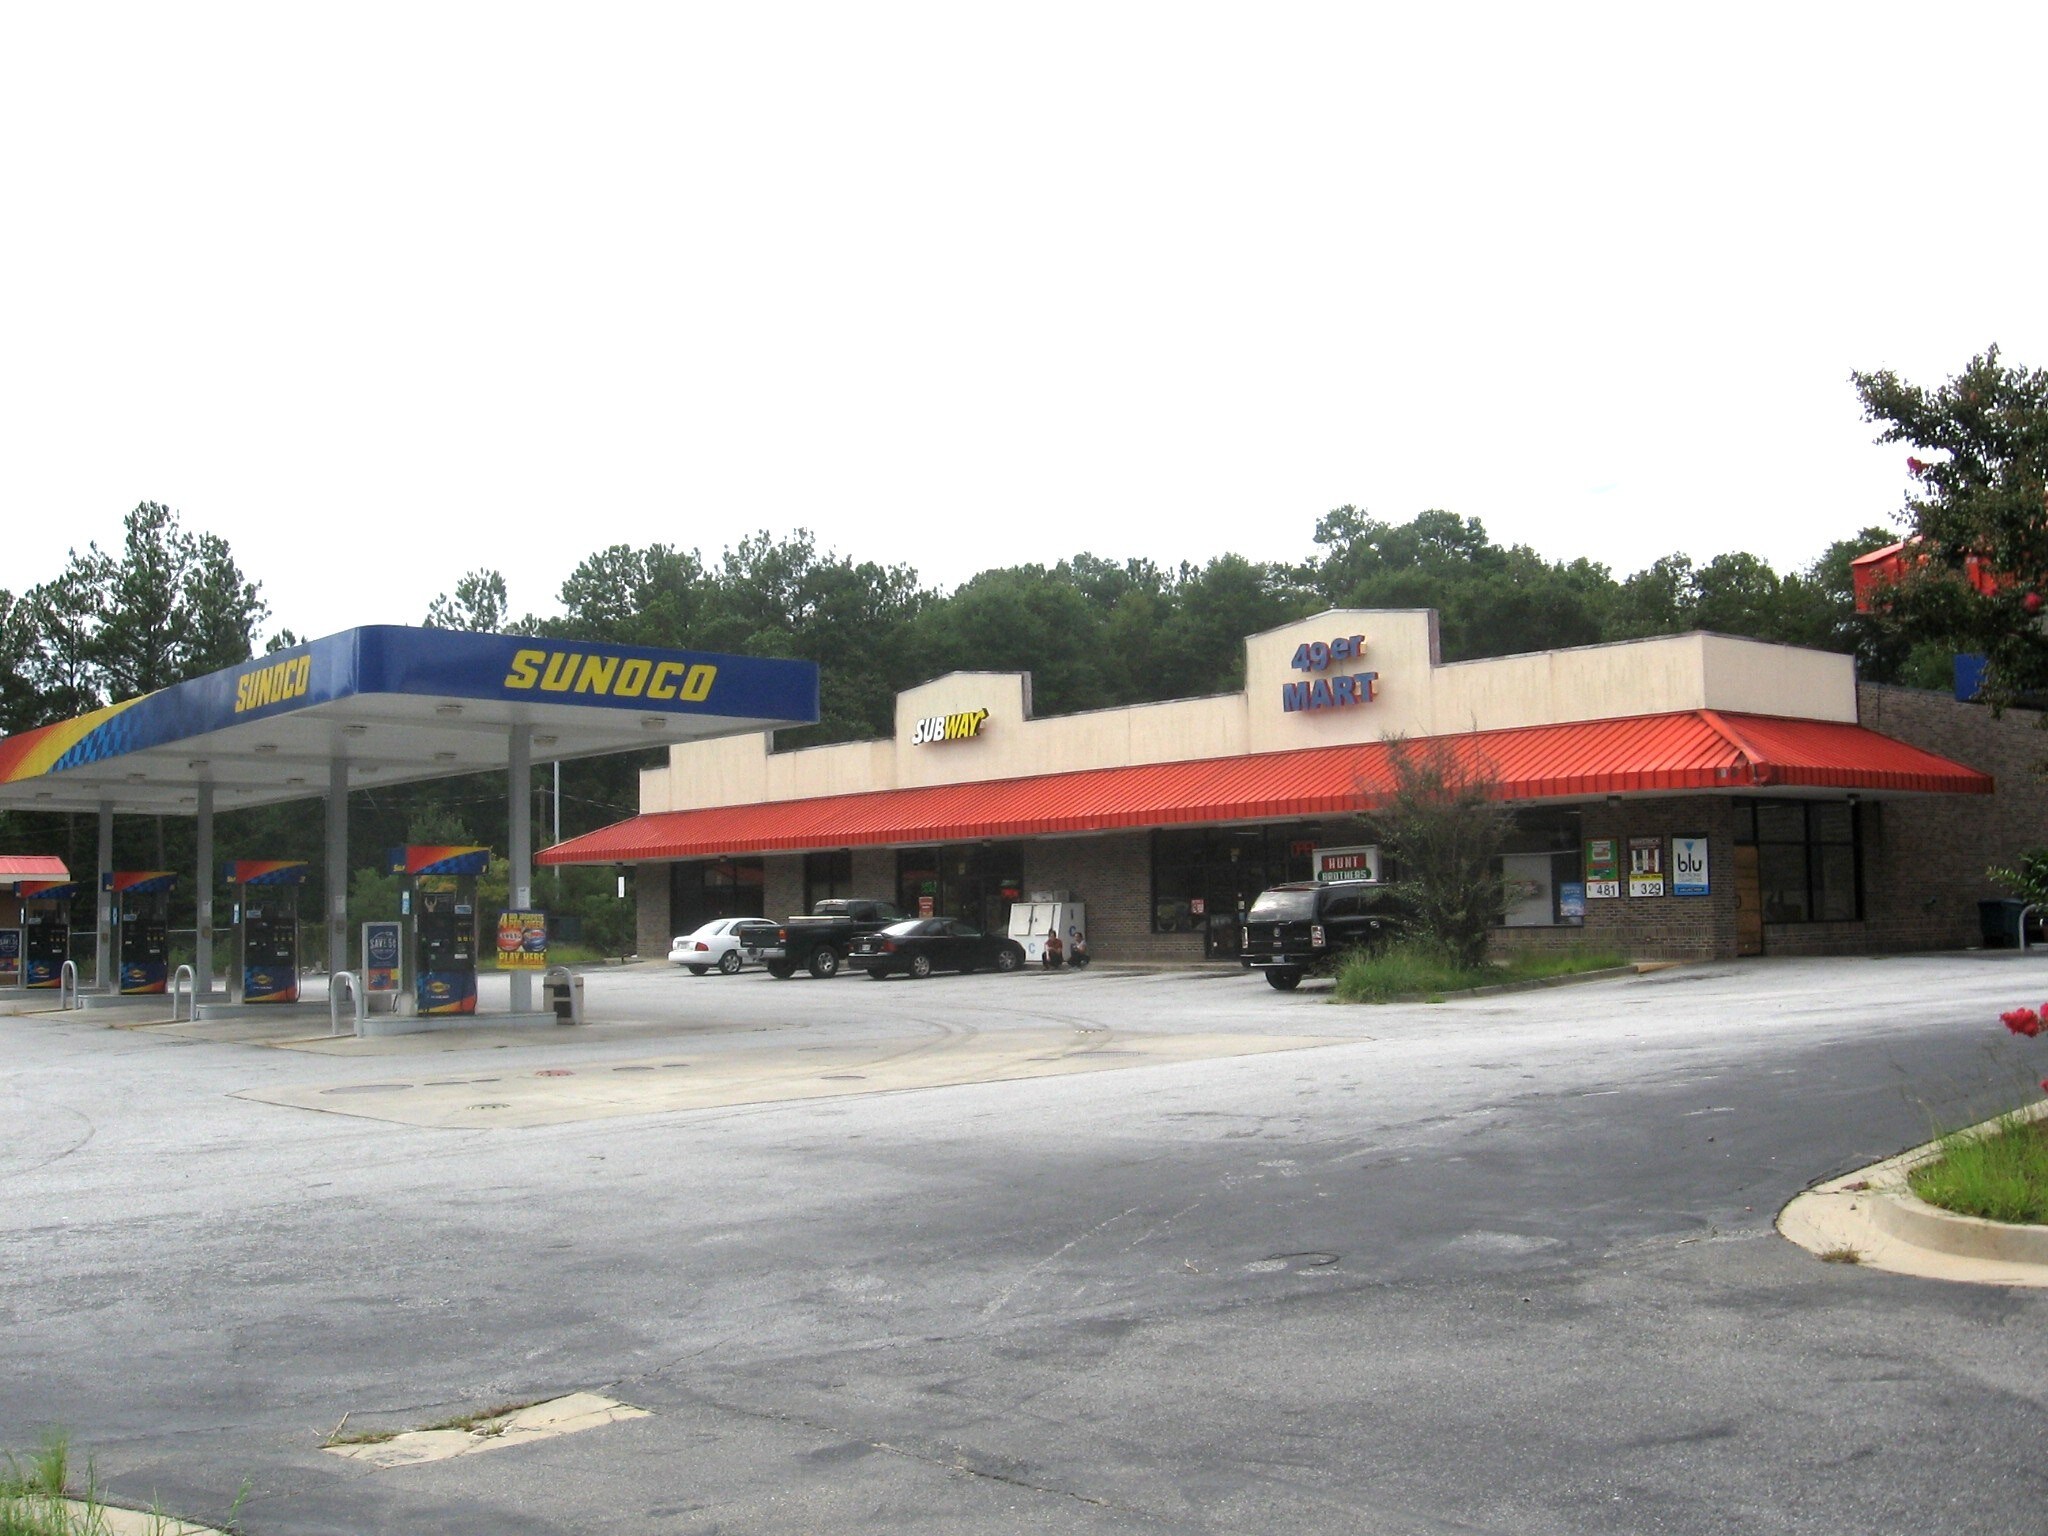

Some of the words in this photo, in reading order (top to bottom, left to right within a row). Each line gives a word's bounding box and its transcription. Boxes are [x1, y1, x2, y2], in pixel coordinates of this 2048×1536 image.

[1291, 633, 1367, 672] 49er
[234, 654, 311, 713] SUNOCO
[504, 649, 717, 702] SUNOCO
[1283, 671, 1379, 712] MART
[911, 707, 989, 746] SUBWAY
[1328, 856, 1359, 870] HUNT
[1677, 853, 1702, 873] blu
[1322, 869, 1367, 881] BROTHERS
[1597, 884, 1616, 898] 481
[1640, 882, 1662, 896] 329
[499, 952, 522, 966] PLAY
[524, 951, 545, 965] HERE
